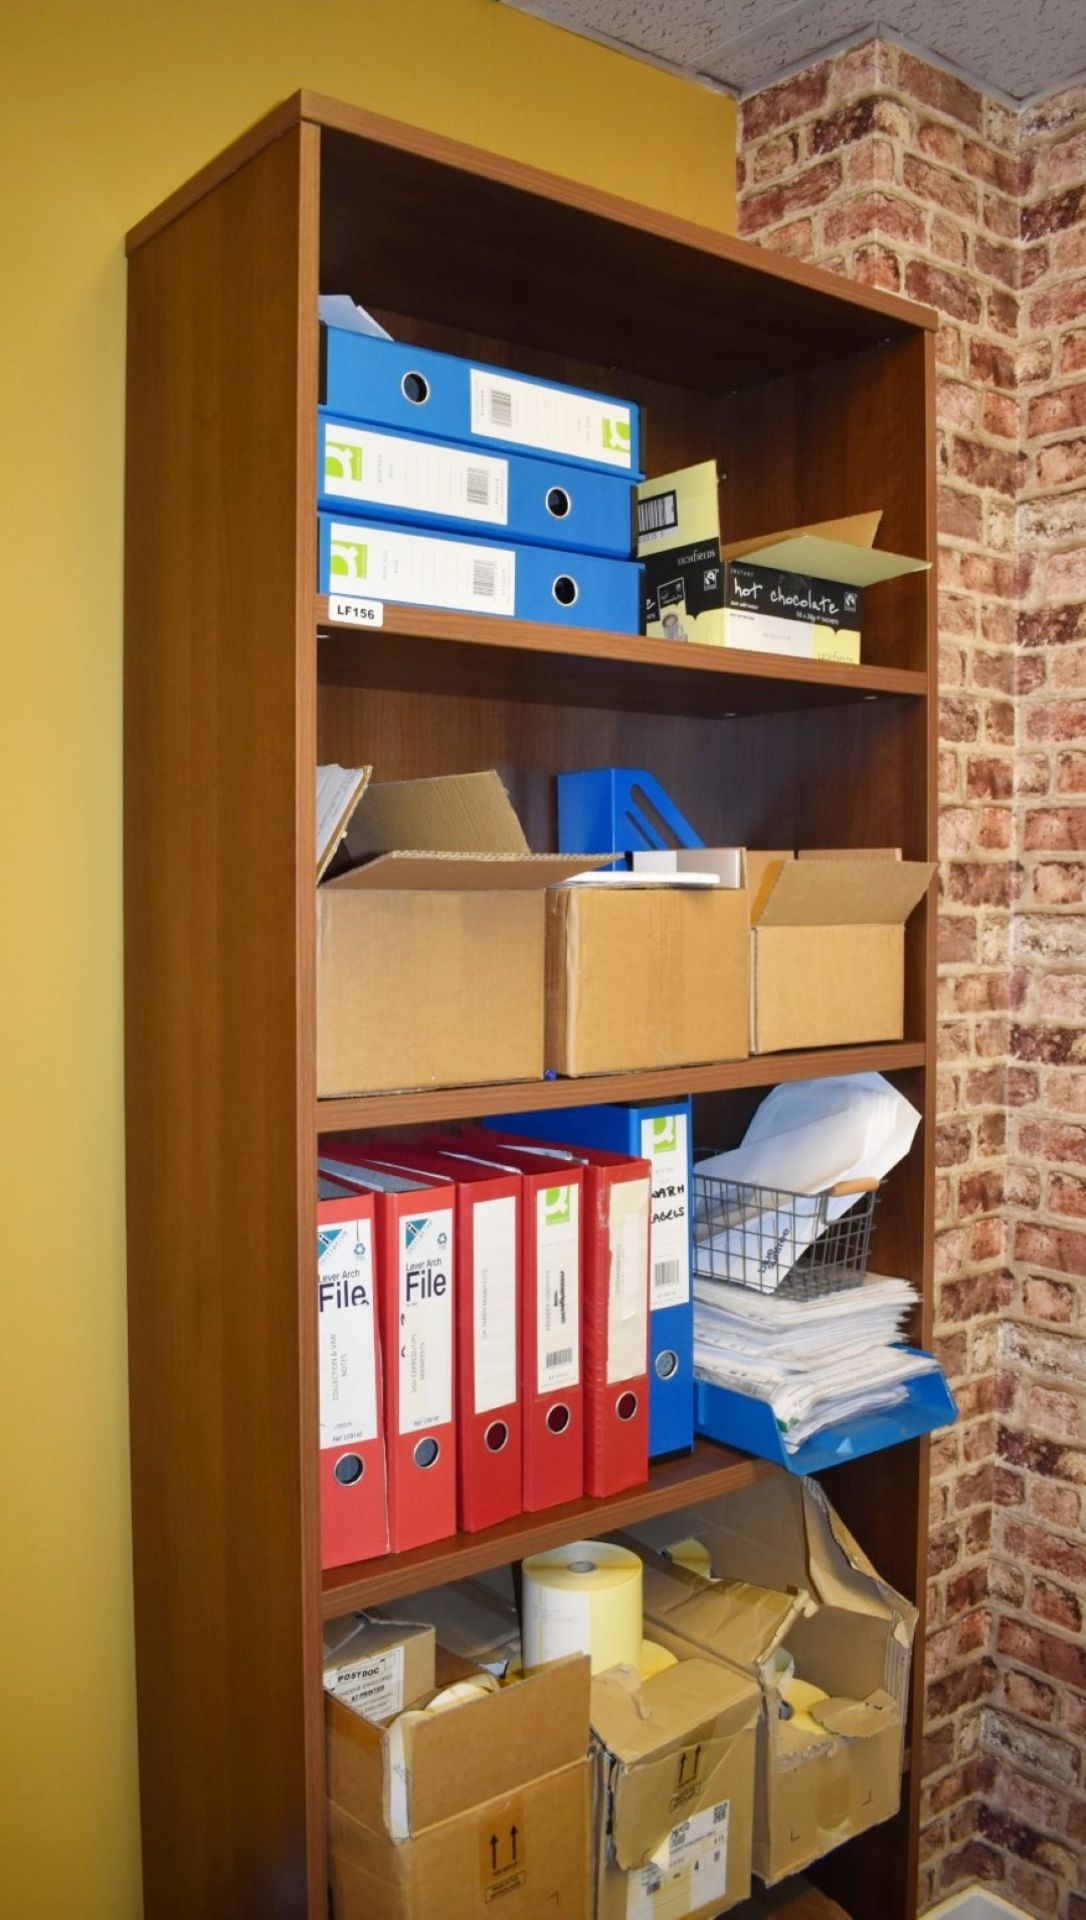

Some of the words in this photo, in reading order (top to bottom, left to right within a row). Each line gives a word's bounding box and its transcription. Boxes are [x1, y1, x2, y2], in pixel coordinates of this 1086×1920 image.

[734, 577, 763, 600] hot
[770, 586, 839, 614] chocolate
[337, 604, 375, 620] LF156
[342, 1269, 360, 1279] Arch
[406, 1261, 425, 1271] Lever
[427, 1258, 442, 1268] Arch
[319, 1280, 366, 1312] File
[406, 1268, 446, 1301] File
[330, 1334, 338, 1350] VAN
[331, 1358, 339, 1401] COLLECTION
